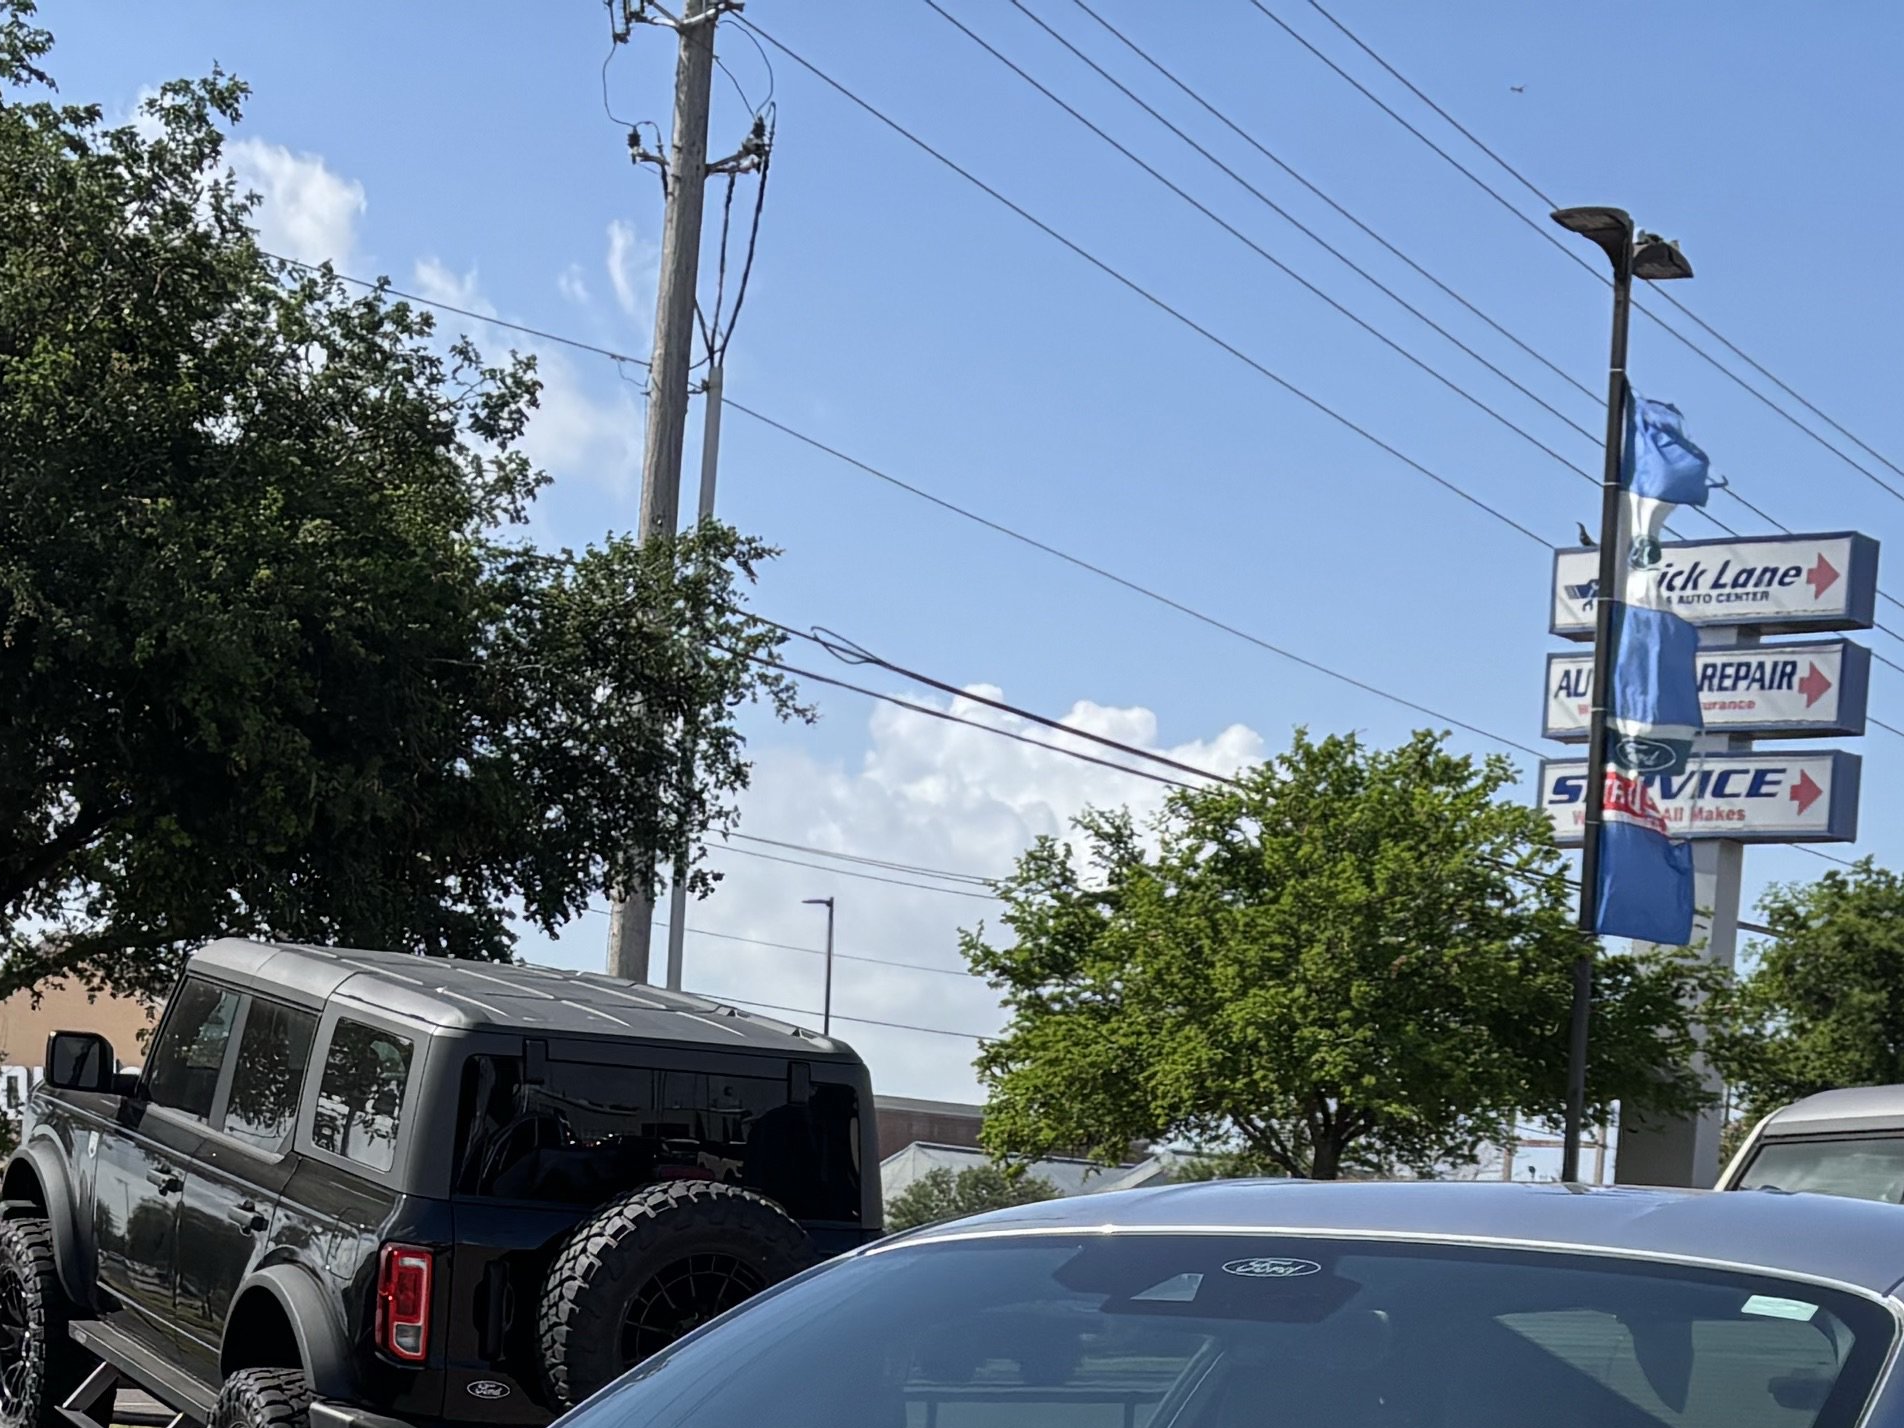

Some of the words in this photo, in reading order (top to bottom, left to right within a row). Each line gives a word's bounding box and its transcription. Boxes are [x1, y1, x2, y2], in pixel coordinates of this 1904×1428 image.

[1709, 559, 1802, 590] Lane
[1678, 593, 1712, 605] AUTO
[1716, 590, 1770, 604] CENTER
[1554, 667, 1592, 698] AU
[1698, 660, 1797, 693] REPAIR
[1692, 807, 1746, 822] Makes
